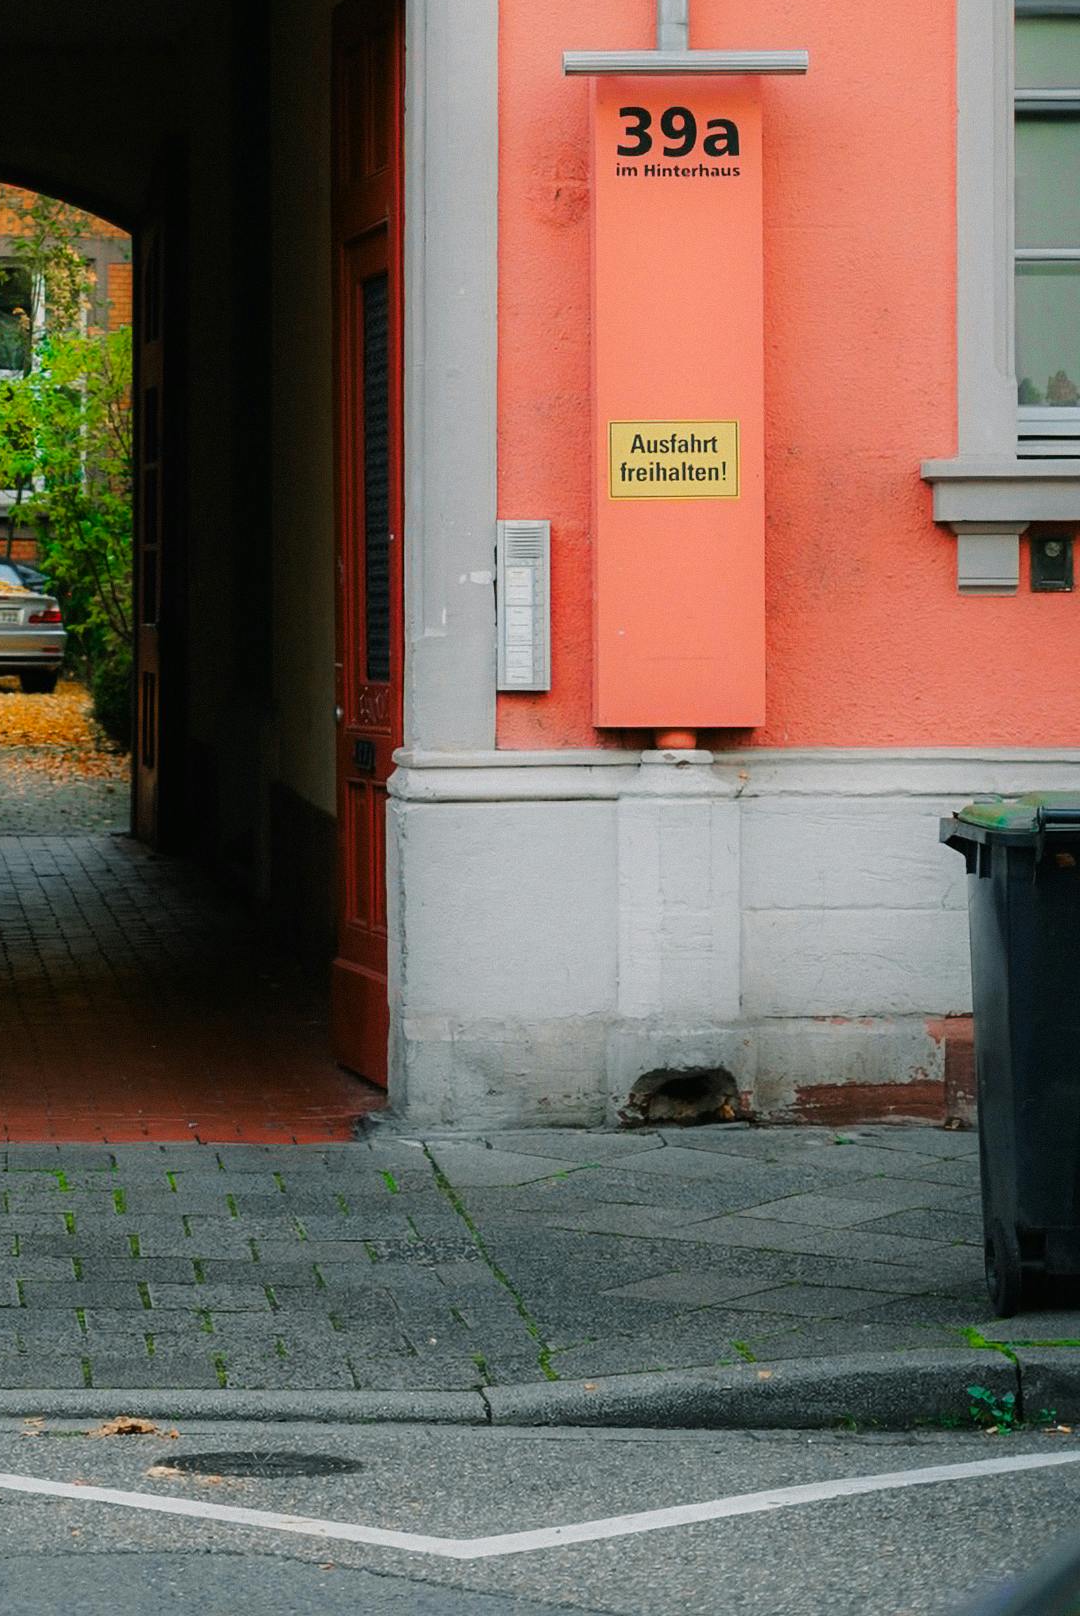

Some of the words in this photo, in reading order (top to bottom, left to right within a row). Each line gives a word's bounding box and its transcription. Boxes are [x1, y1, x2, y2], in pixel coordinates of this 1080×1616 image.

[617, 105, 740, 158] 39a
[616, 163, 638, 177] im
[644, 163, 741, 178] Hinterhaus
[630, 433, 718, 454] Ausfahrt
[620, 461, 727, 482] freihalten!
